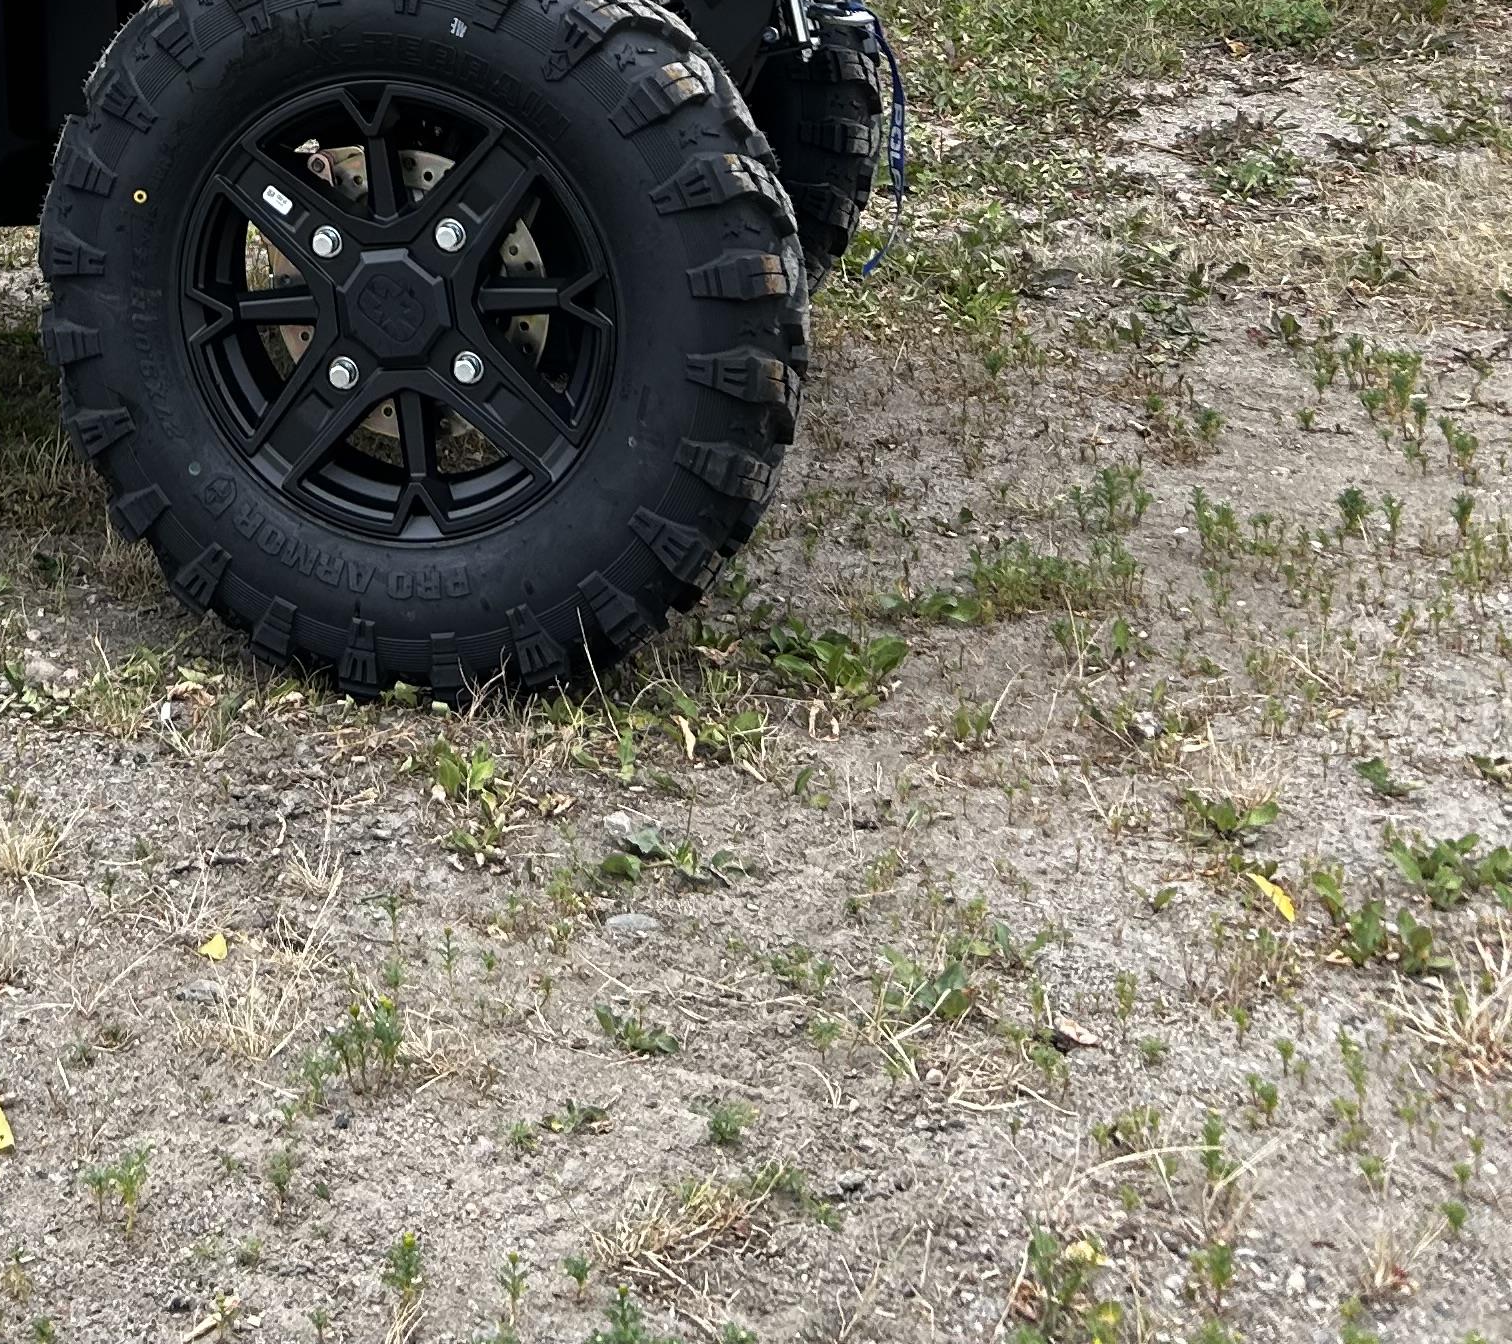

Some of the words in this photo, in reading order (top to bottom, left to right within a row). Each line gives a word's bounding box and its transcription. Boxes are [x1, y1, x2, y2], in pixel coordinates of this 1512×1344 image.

[301, 31, 571, 141] X-TERRAIN
[231, 503, 377, 594] ARMOR
[386, 566, 472, 600] PRO
